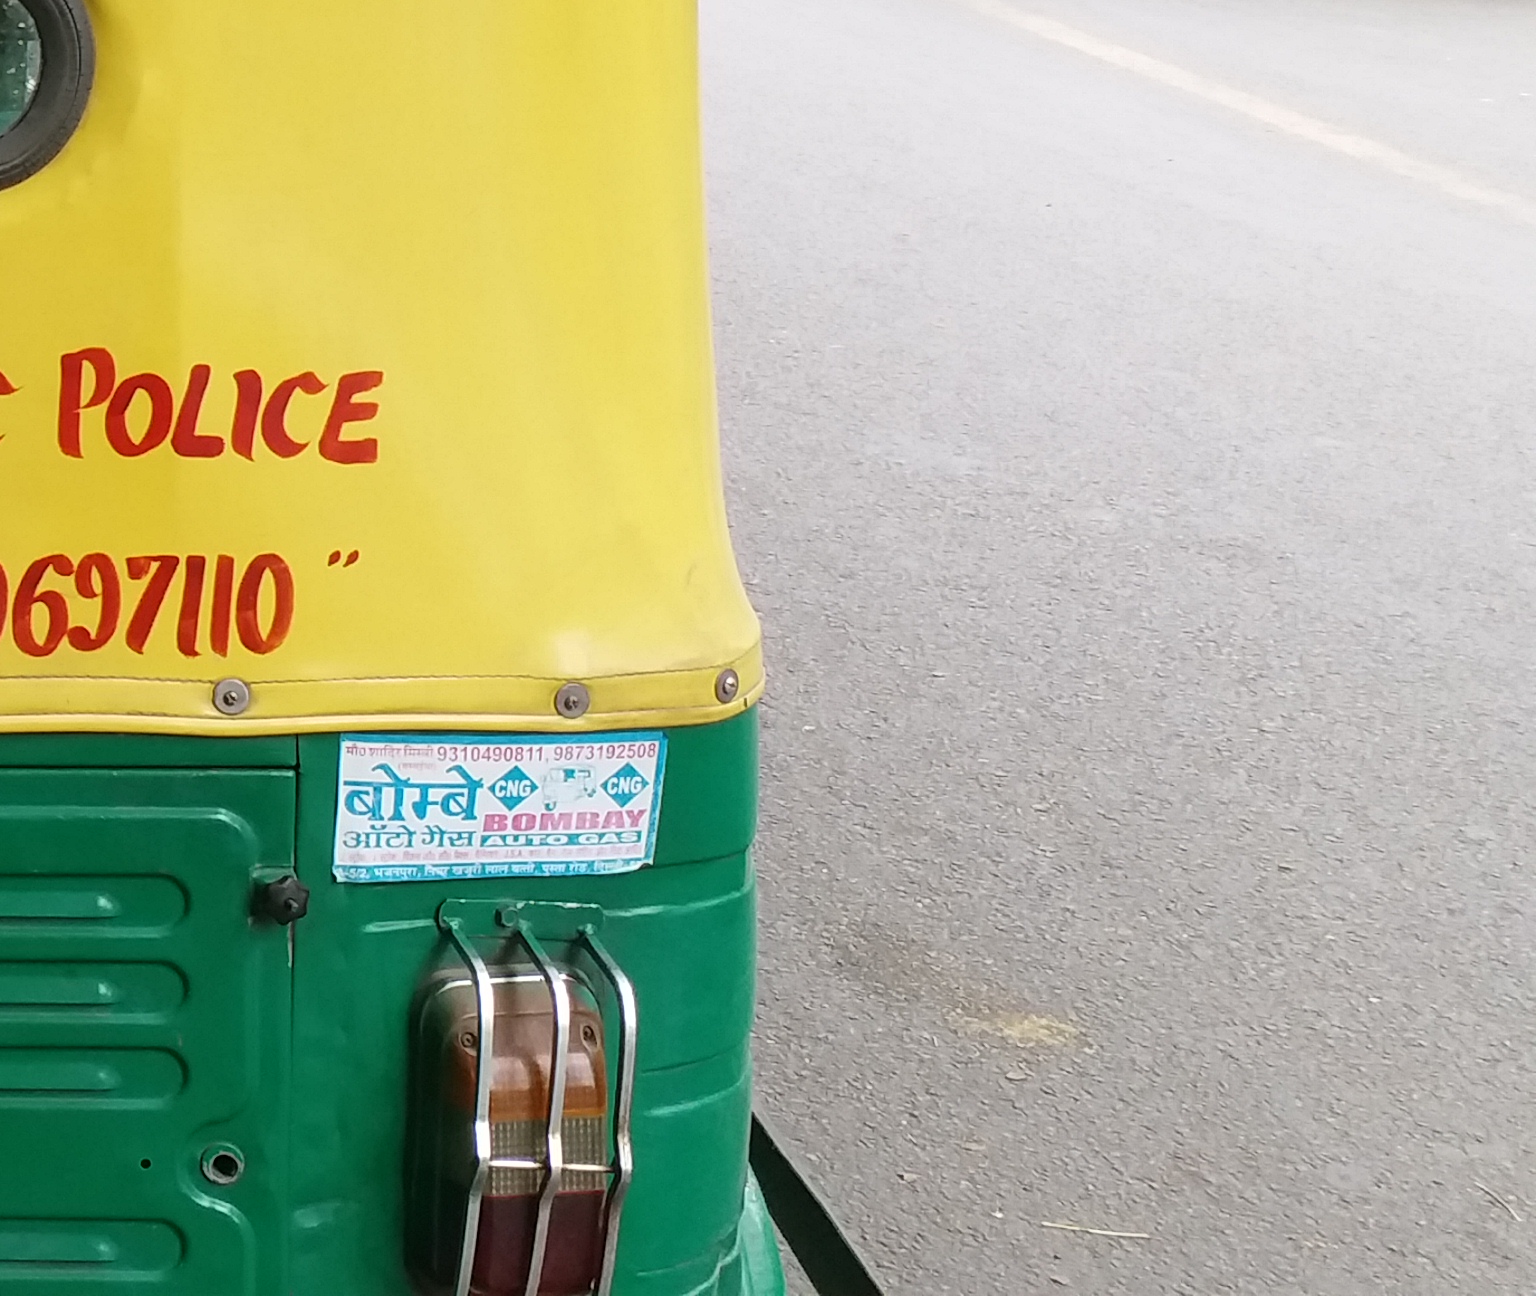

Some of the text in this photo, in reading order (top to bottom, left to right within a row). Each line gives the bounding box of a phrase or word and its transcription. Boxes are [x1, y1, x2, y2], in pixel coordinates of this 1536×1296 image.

[58, 347, 384, 464] POLICE
[553, 743, 656, 761] 9873192508
[343, 763, 484, 821] बोम्बे
[494, 779, 532, 798] CNG
[606, 775, 642, 794] CNG
[482, 809, 647, 833] BOMBAY
[420, 825, 477, 848] गैस
[483, 832, 638, 846] AUTO GAS
